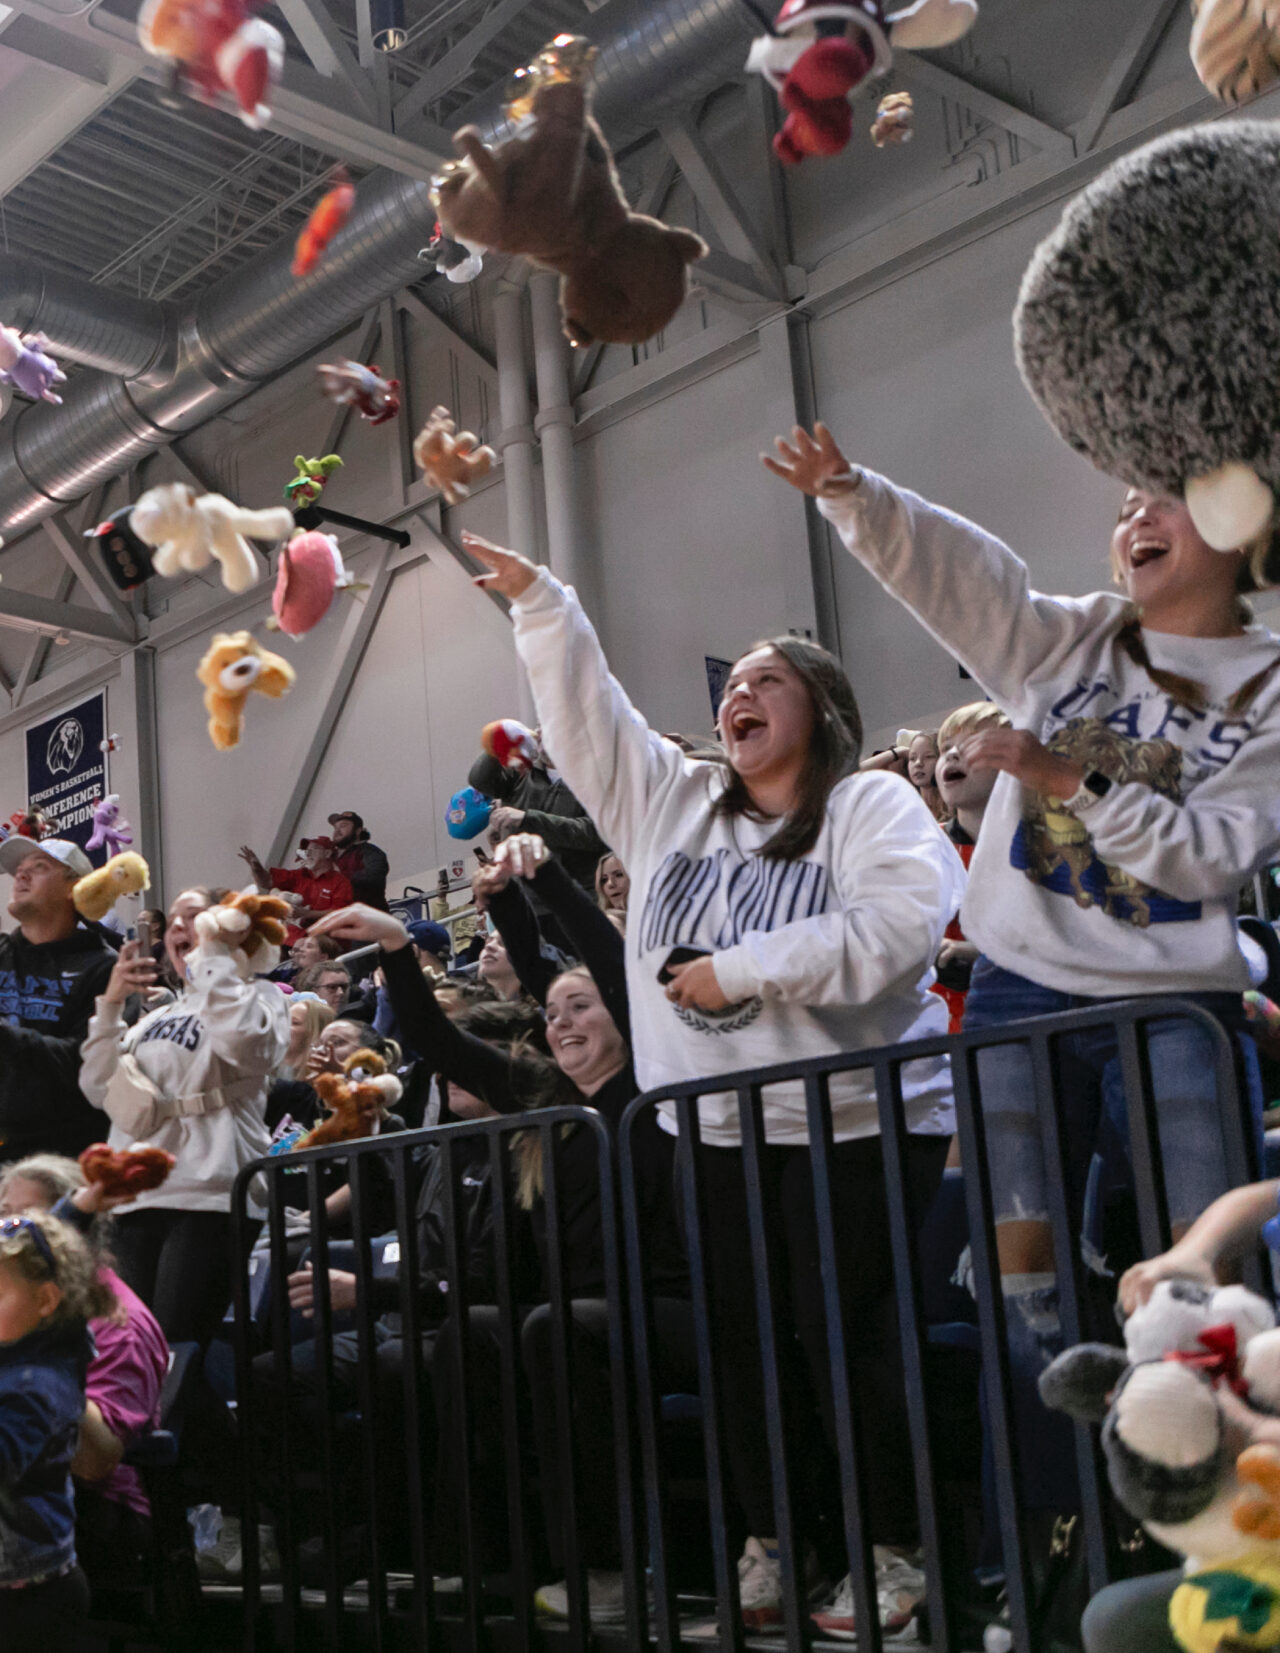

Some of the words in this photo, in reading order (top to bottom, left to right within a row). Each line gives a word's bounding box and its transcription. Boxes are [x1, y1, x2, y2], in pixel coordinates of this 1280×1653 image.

[30, 784, 61, 805] WOMEN'S
[60, 764, 105, 793] BASKETBALL
[41, 783, 102, 820] NFERENCE
